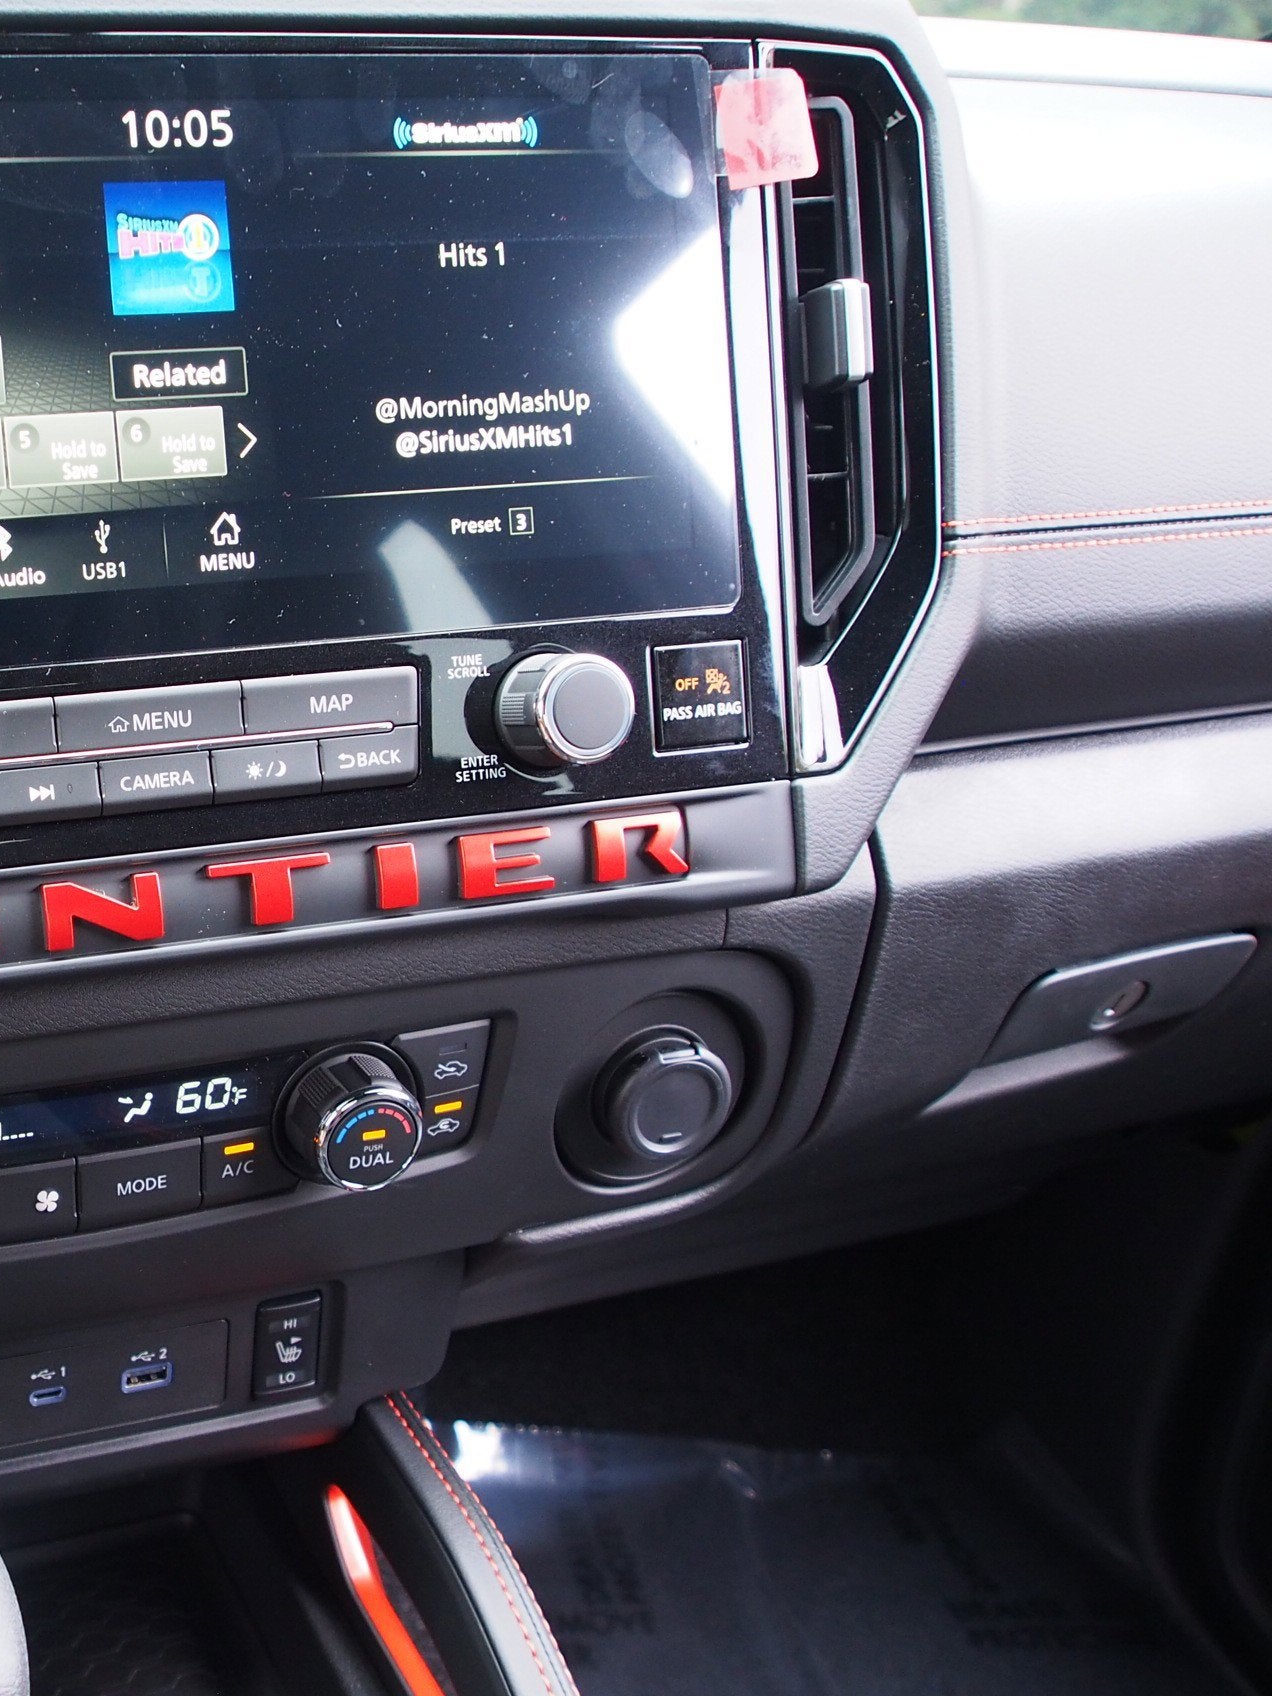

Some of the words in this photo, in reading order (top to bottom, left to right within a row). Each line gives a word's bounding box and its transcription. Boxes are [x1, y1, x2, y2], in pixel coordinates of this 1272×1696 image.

[121, 110, 234, 148] 10:05
[438, 243, 488, 268] Hits
[495, 242, 506, 266] 1
[132, 361, 228, 388] Related
[375, 388, 591, 425] @MorningMashUp
[19, 431, 32, 450] 5
[130, 424, 143, 443] 6
[162, 433, 198, 454] Hold
[200, 435, 216, 451] to
[395, 424, 573, 458] @SiriusXMHits1
[51, 440, 88, 460] Hold
[90, 442, 107, 458] to
[62, 461, 99, 480] Save
[172, 454, 208, 474] Save
[450, 515, 501, 535] Preset
[82, 561, 127, 581] USB1
[199, 551, 256, 573] MENU
[450, 653, 484, 668] TUNE
[447, 664, 491, 680] SCROLL
[674, 676, 700, 693] OFF
[309, 694, 354, 715] MAP
[663, 706, 693, 721] PASS
[694, 704, 716, 718] AIR
[716, 701, 742, 716] BAG
[132, 711, 193, 733] MENU
[357, 749, 402, 769] BACK
[460, 754, 499, 769] ENTER
[119, 770, 195, 792] CAMERA
[454, 766, 507, 783] SETTING
[363, 1143, 385, 1154] PUSH
[221, 1158, 257, 1179] A/C
[348, 1150, 395, 1171] DUAL
[116, 1174, 168, 1196] MODE
[282, 1318, 298, 1331] HI
[158, 1347, 168, 1360] 2
[278, 1371, 296, 1385] LO
